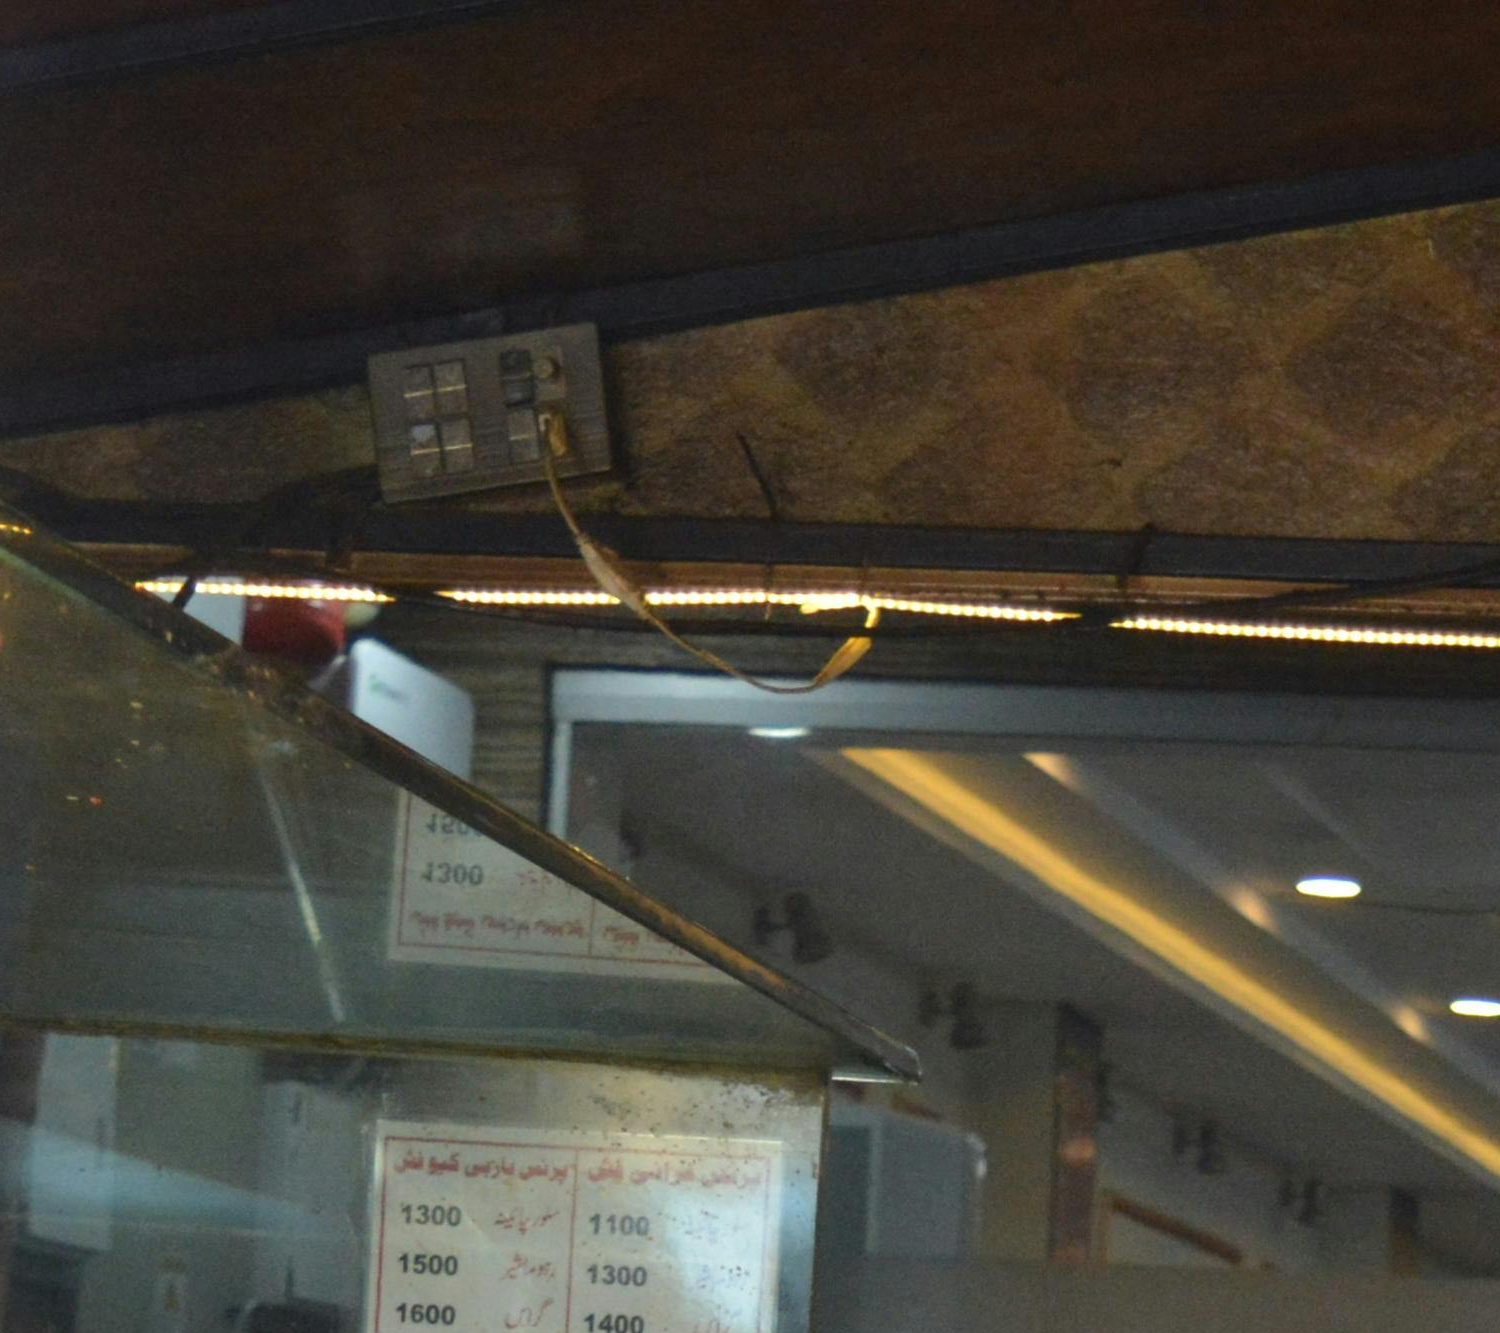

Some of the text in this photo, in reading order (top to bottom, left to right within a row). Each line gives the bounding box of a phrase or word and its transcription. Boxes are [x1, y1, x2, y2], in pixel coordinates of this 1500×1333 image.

[401, 1204, 462, 1227] 1300
[589, 1213, 648, 1236] 1100
[398, 1253, 458, 1276] 1500
[586, 1264, 648, 1287] 1300
[396, 1302, 456, 1326] 1600
